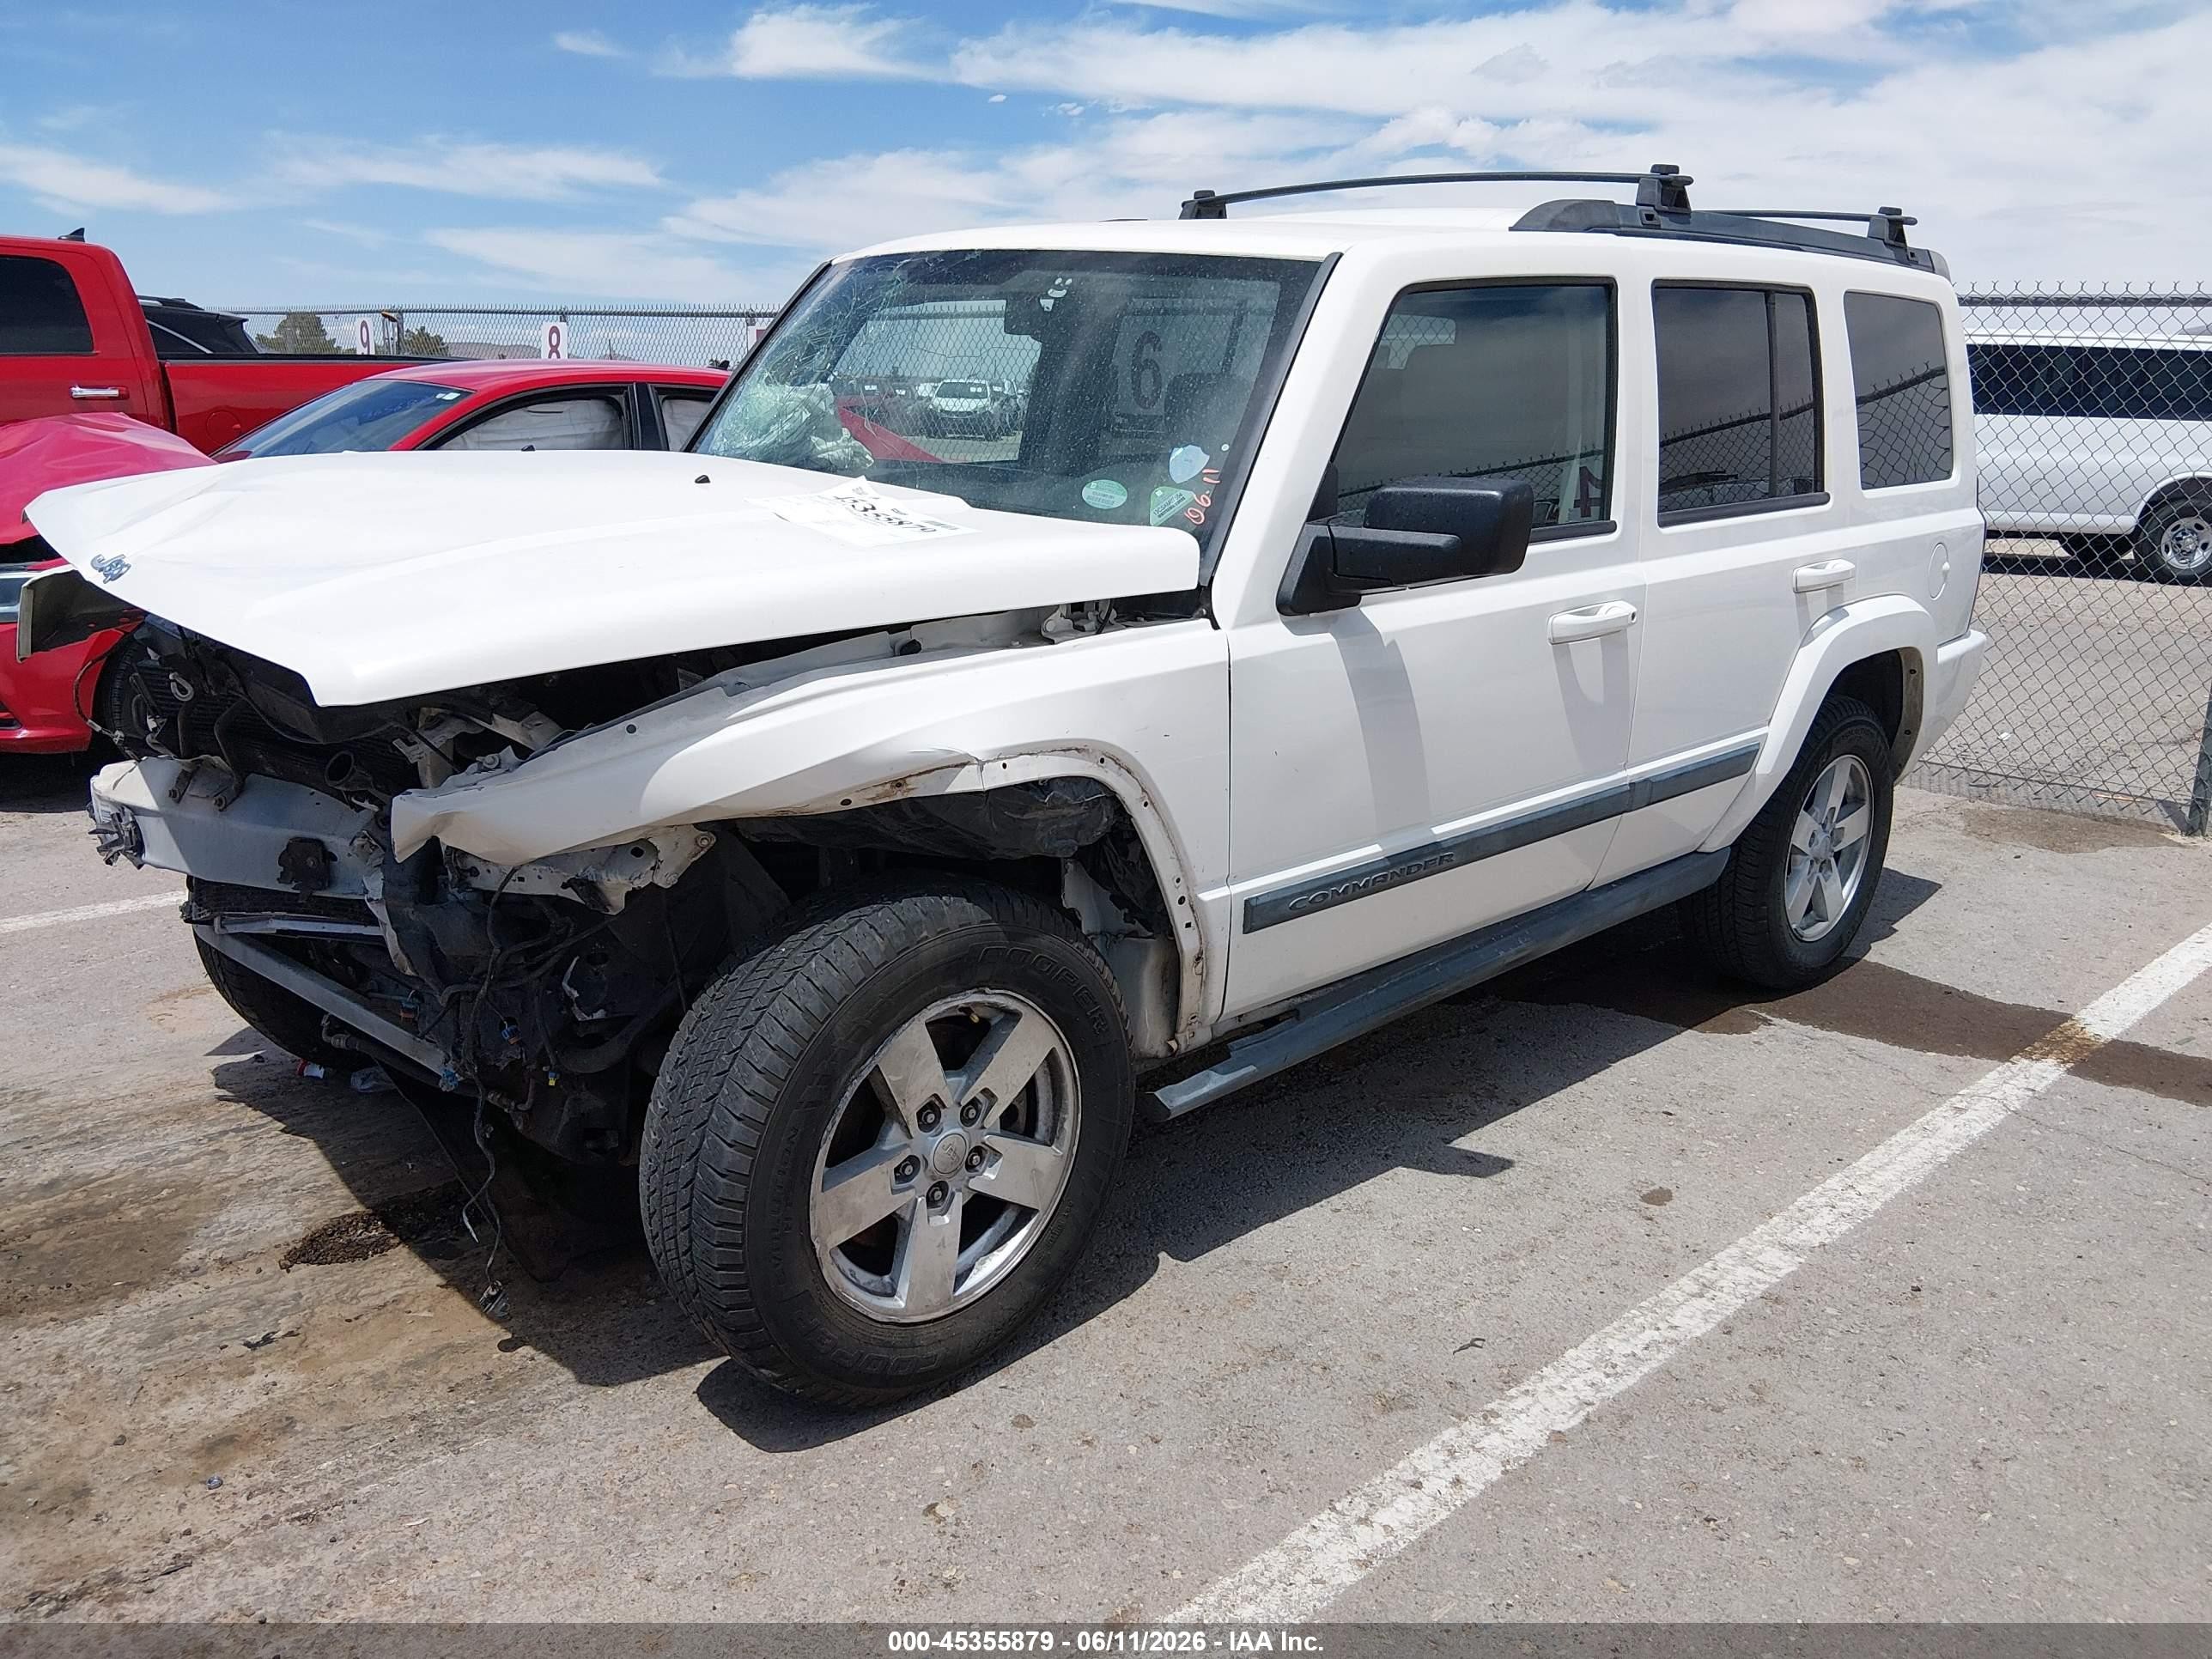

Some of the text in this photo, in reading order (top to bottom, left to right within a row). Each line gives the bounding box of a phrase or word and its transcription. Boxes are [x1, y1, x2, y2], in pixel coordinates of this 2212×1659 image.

[360, 319, 370, 355] 9
[548, 325, 561, 359] 8
[1131, 330, 1162, 410] 6
[1288, 851, 1455, 911] COMMANDER
[977, 945, 1109, 1037] COOPER
